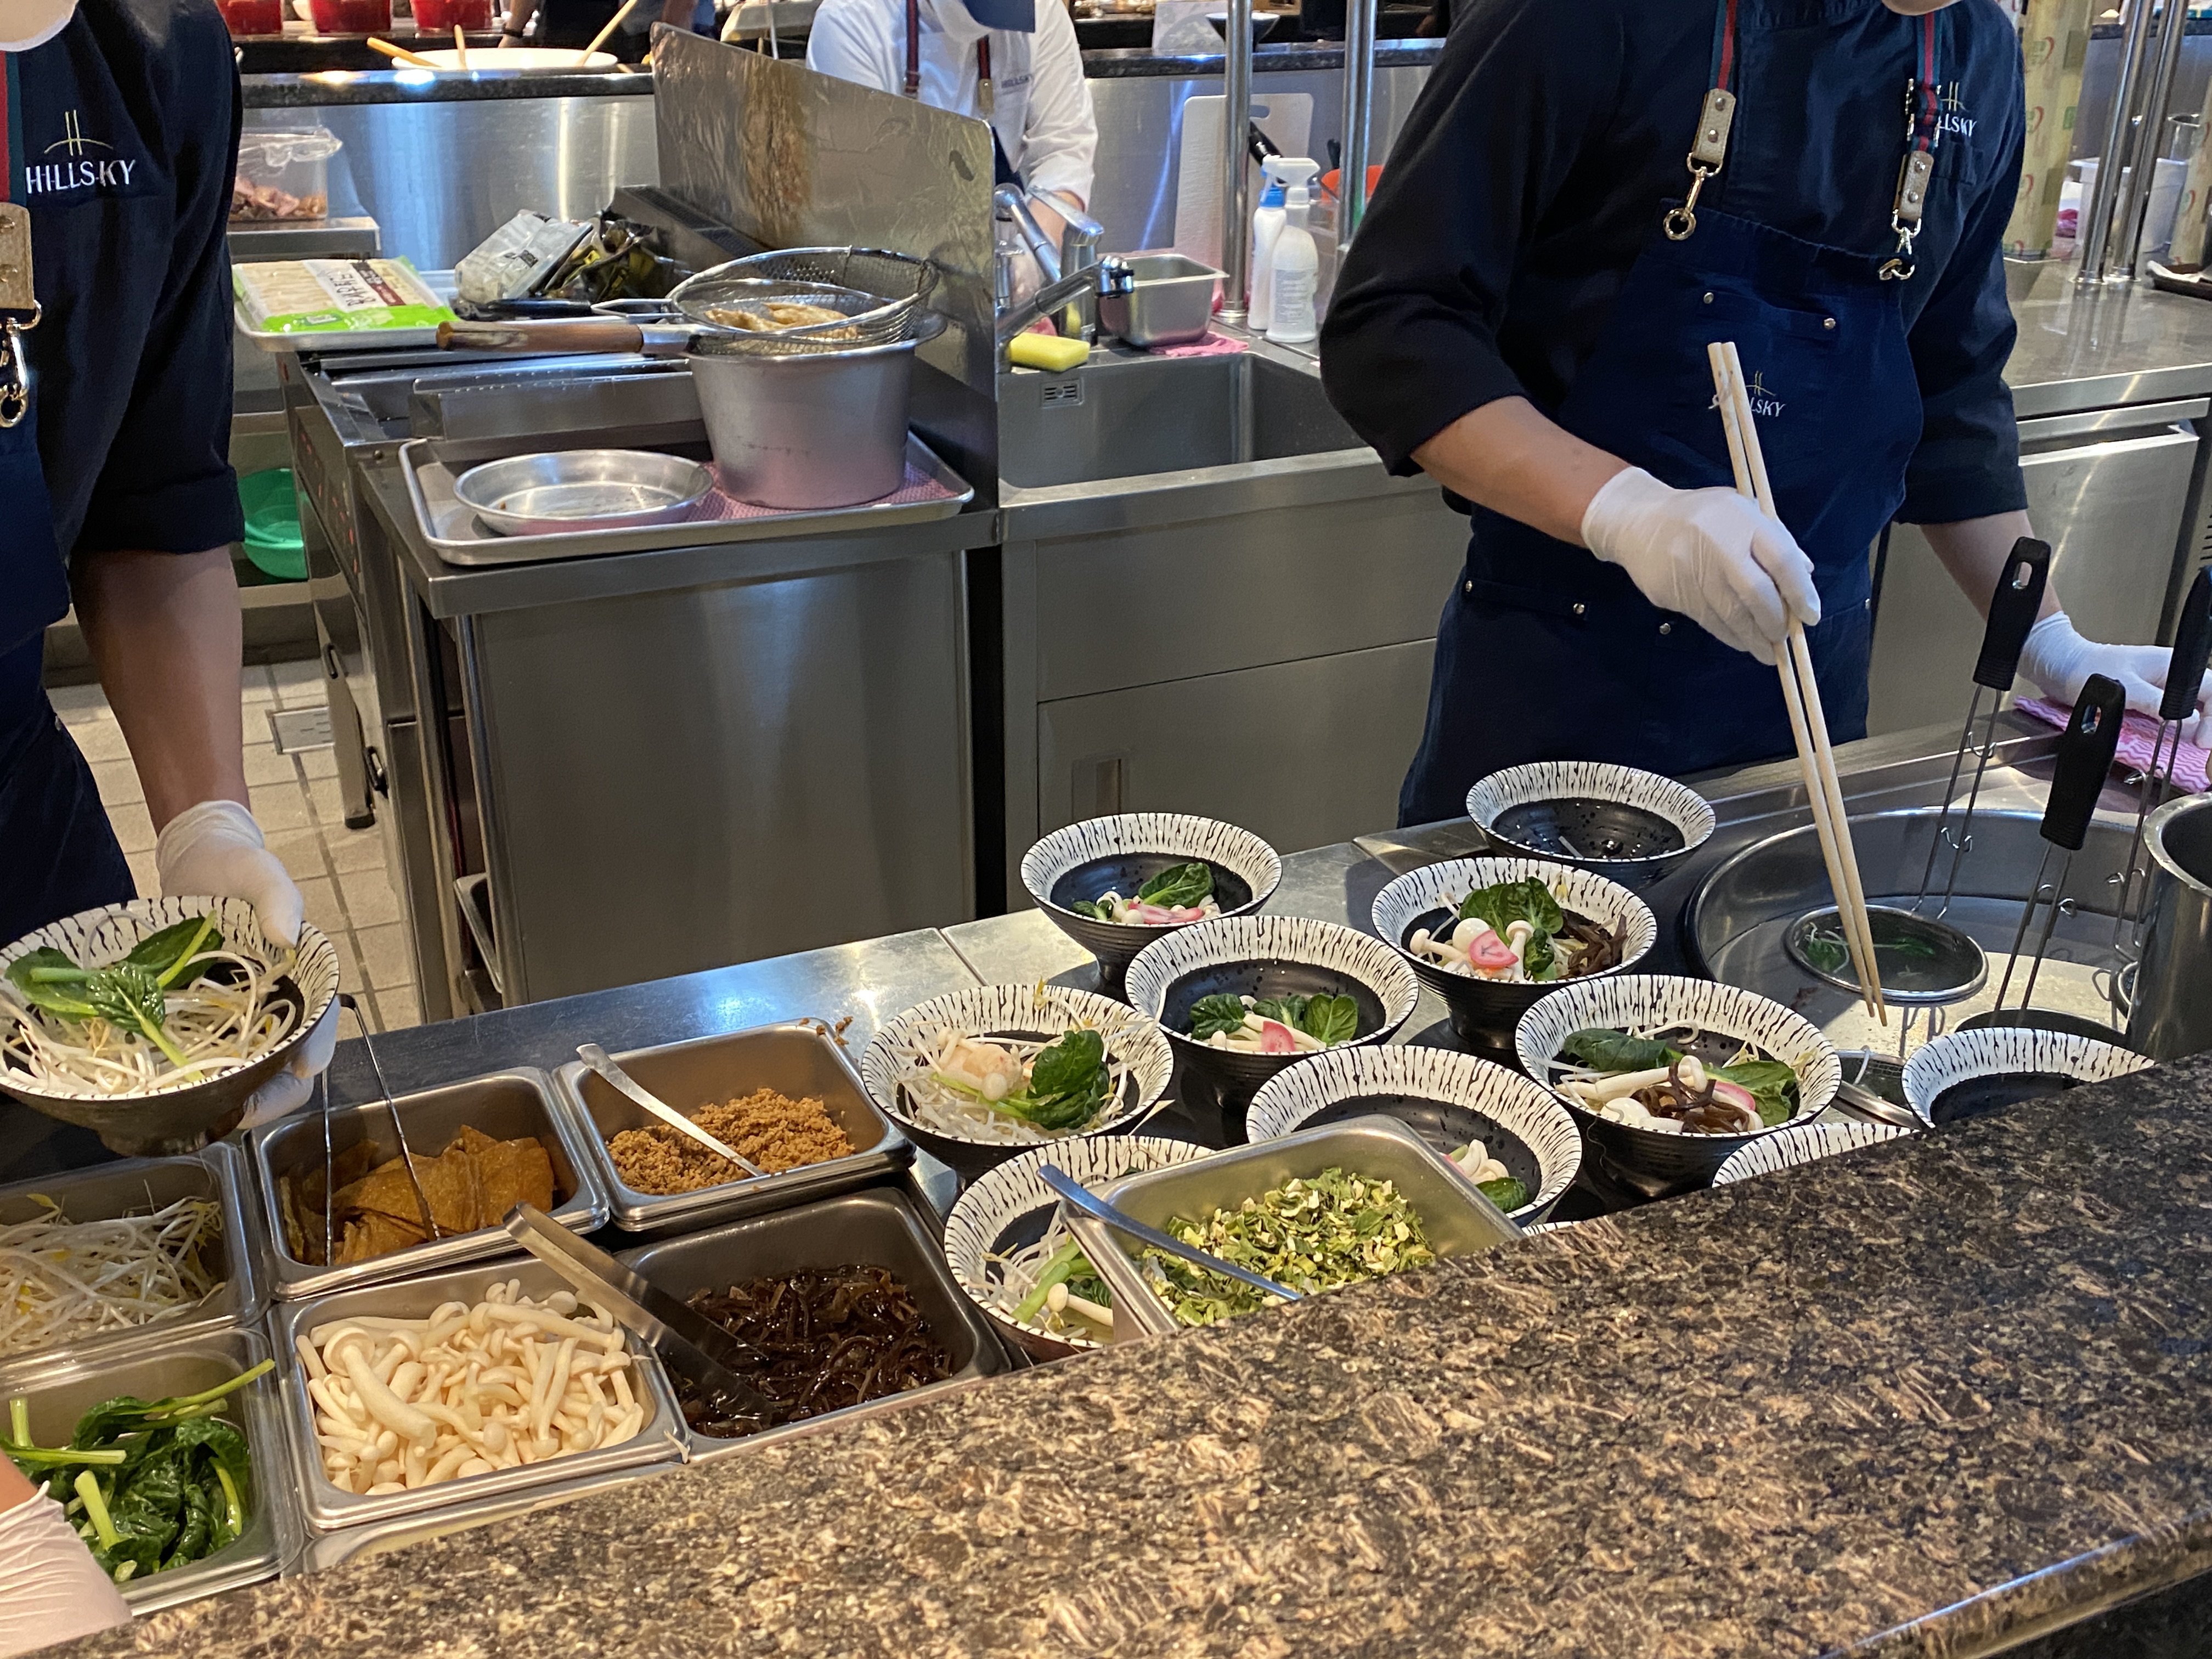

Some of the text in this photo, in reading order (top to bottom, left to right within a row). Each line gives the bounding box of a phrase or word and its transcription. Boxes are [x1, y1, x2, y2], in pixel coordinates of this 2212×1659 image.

[1940, 113, 1977, 137] LSKY
[25, 159, 136, 194] HILLSKY
[1750, 397, 1786, 417] LSKY
